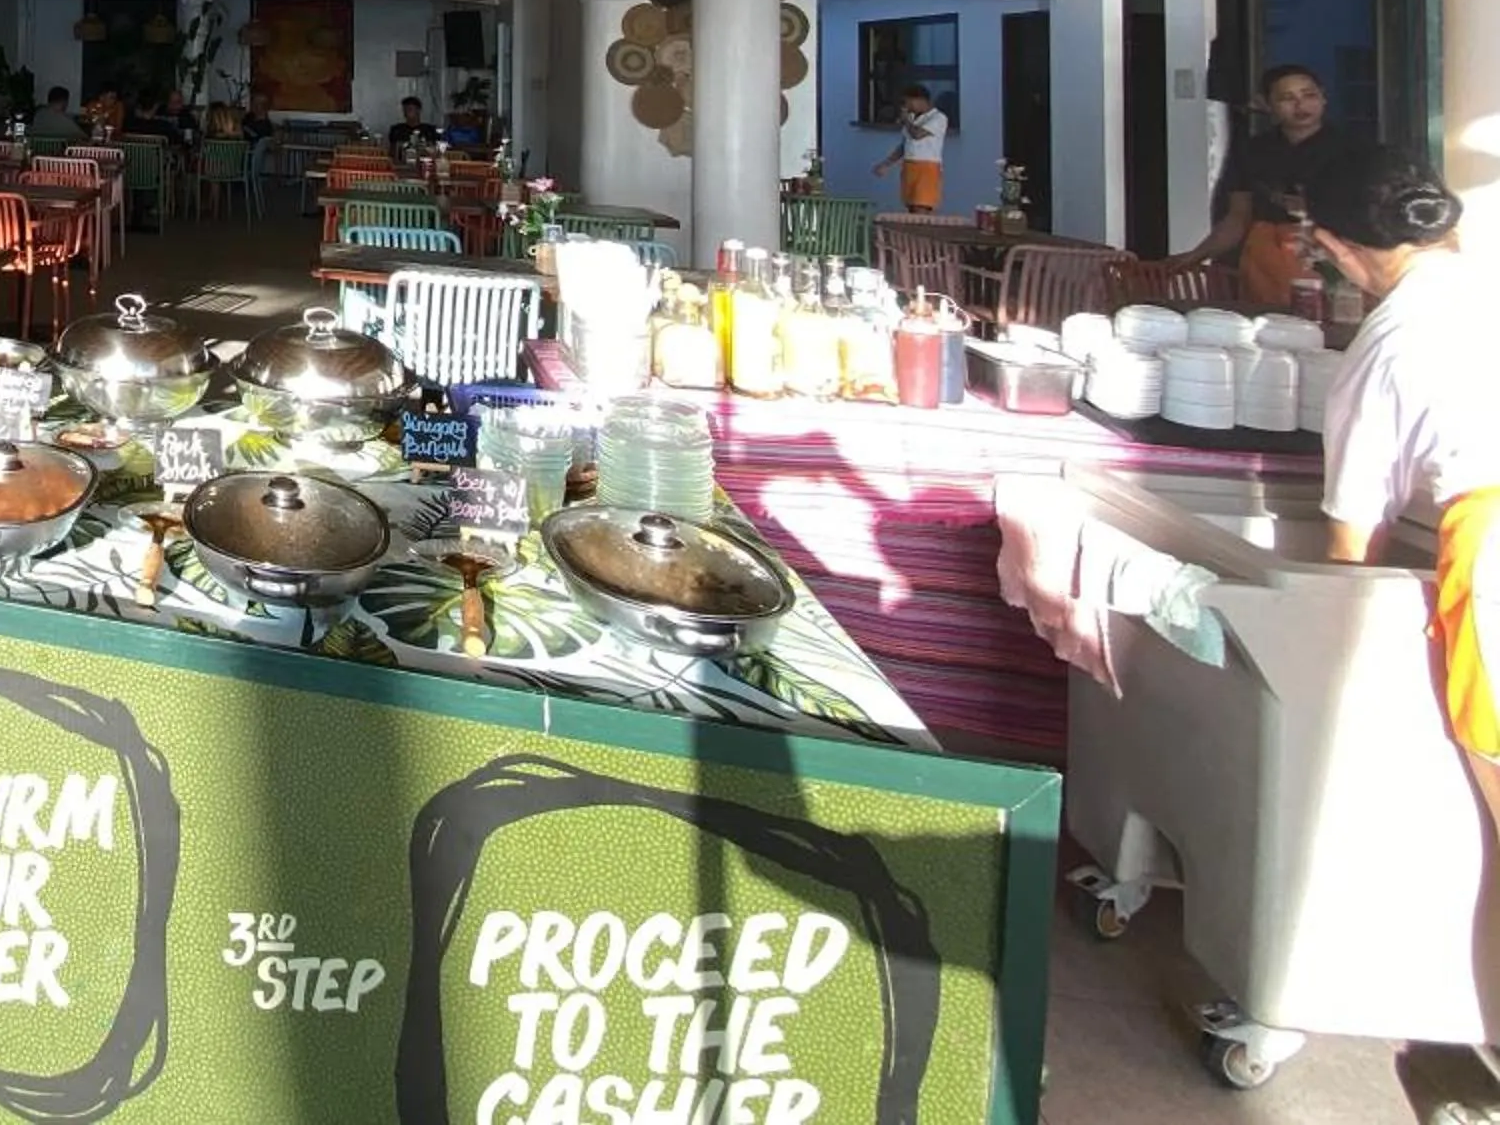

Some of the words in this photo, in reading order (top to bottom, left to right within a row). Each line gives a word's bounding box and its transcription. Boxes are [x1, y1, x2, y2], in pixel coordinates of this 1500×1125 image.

[251, 954, 386, 1014] STEP
[468, 909, 851, 995] PROCEED
[507, 990, 607, 1073] TO
[642, 993, 800, 1075] THE
[475, 1071, 823, 1125] CASHIER
